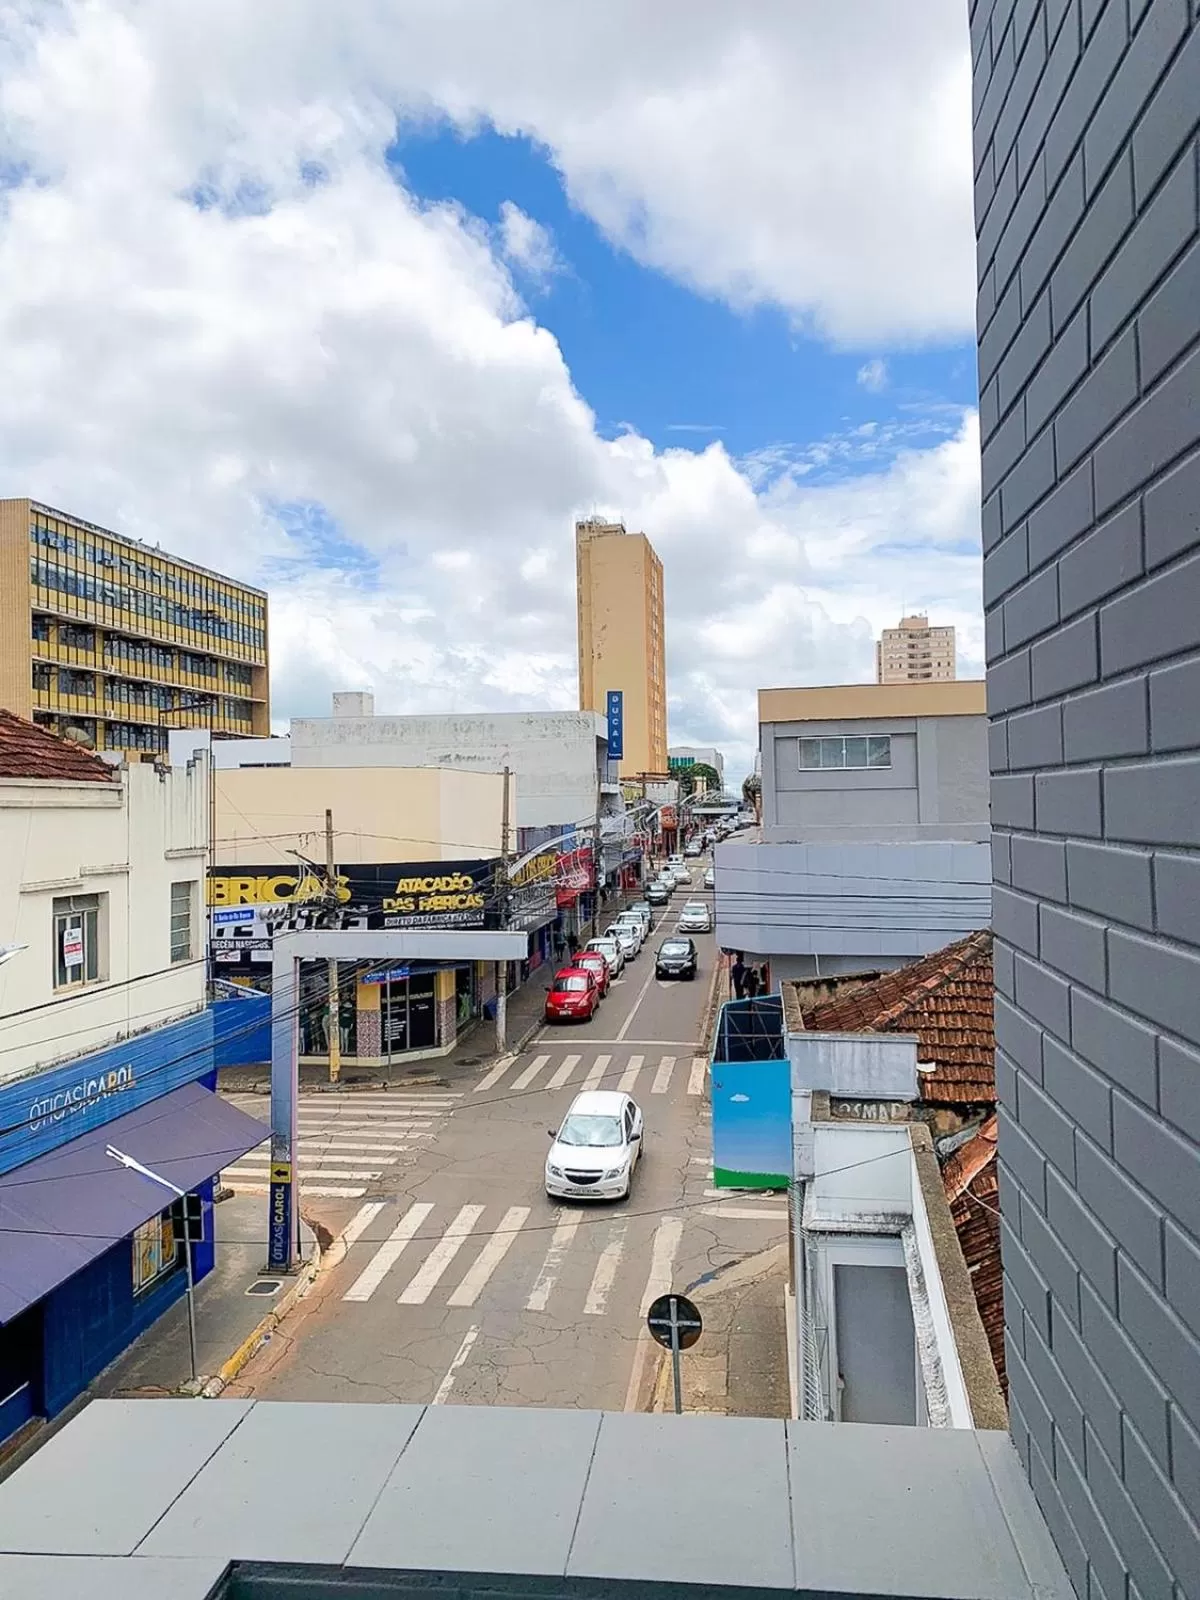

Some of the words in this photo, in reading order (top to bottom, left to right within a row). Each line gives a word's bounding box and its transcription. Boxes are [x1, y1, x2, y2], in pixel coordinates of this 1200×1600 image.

[396, 872, 473, 894] ATACADÃO
[383, 897, 416, 912] DAS
[419, 892, 485, 911] FÁBRICAS
